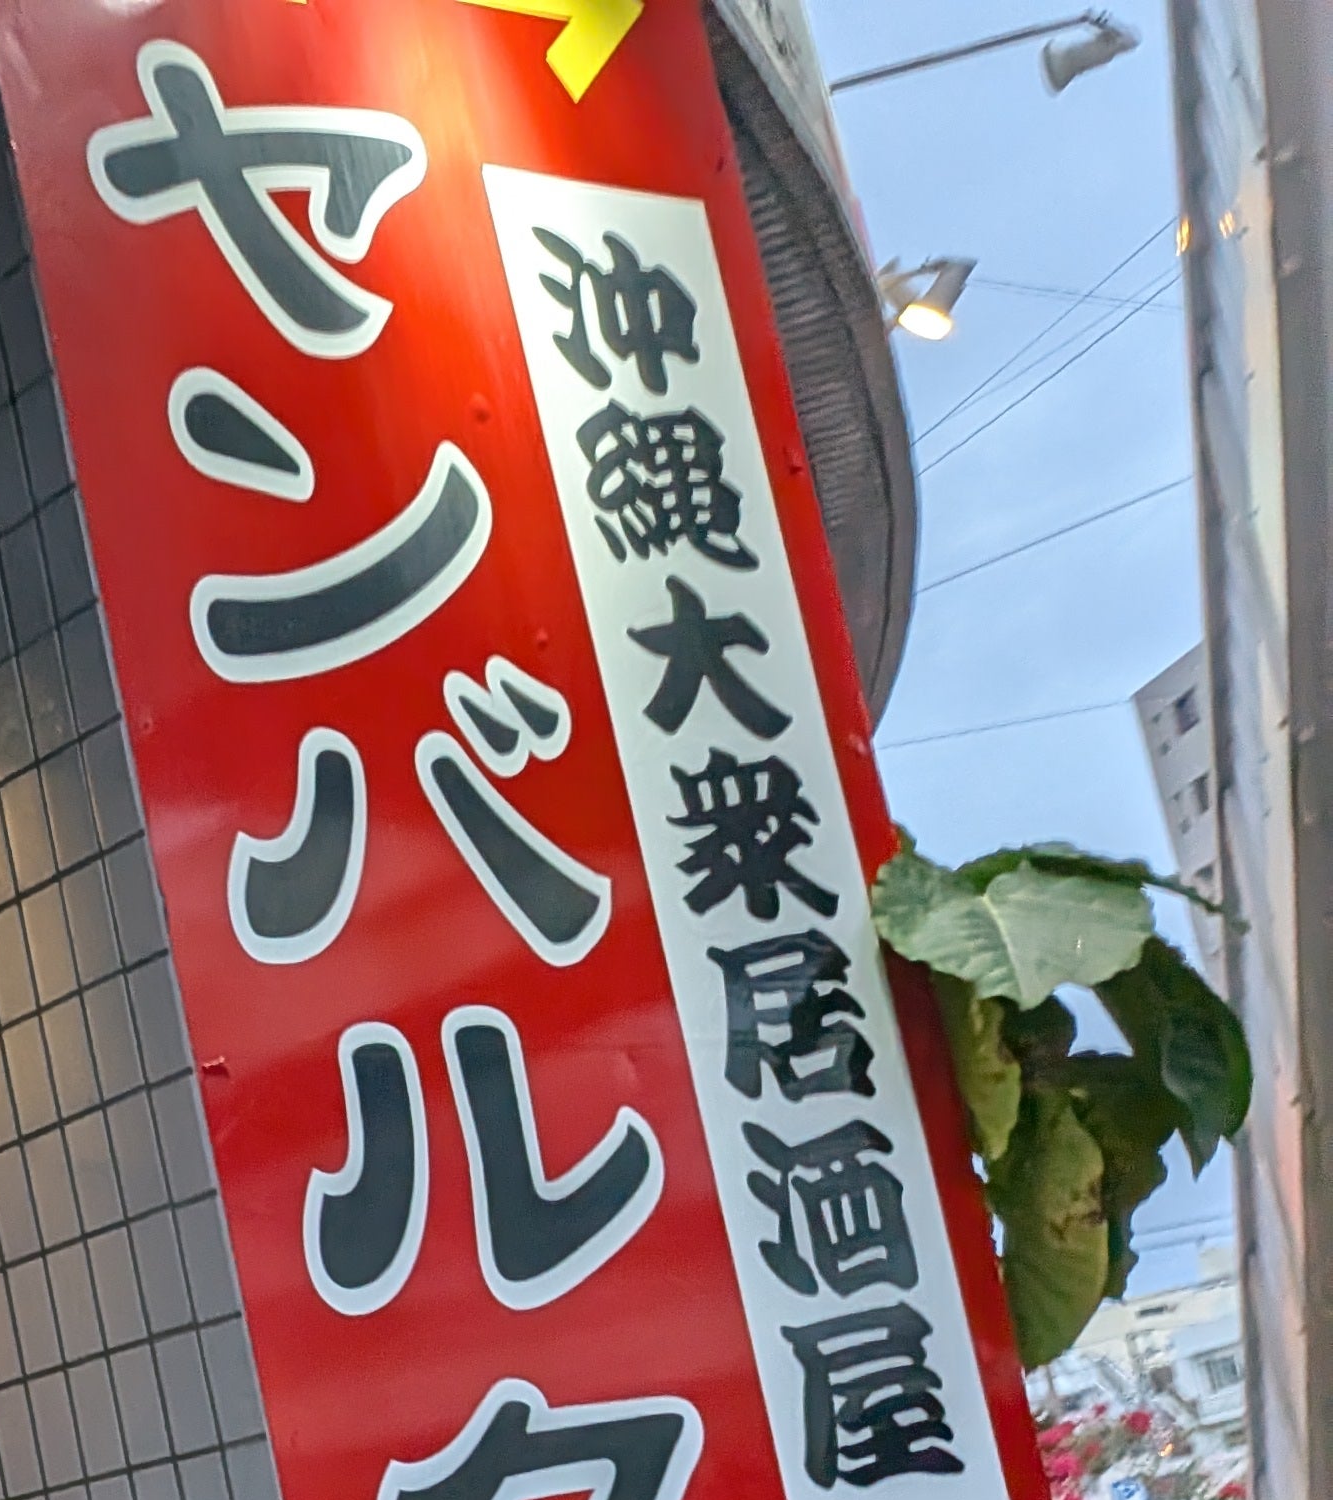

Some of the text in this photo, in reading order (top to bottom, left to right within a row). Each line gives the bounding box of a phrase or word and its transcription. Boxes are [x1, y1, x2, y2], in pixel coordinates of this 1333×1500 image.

[532, 224, 966, 1490] 沖縄大衆居酒屋
